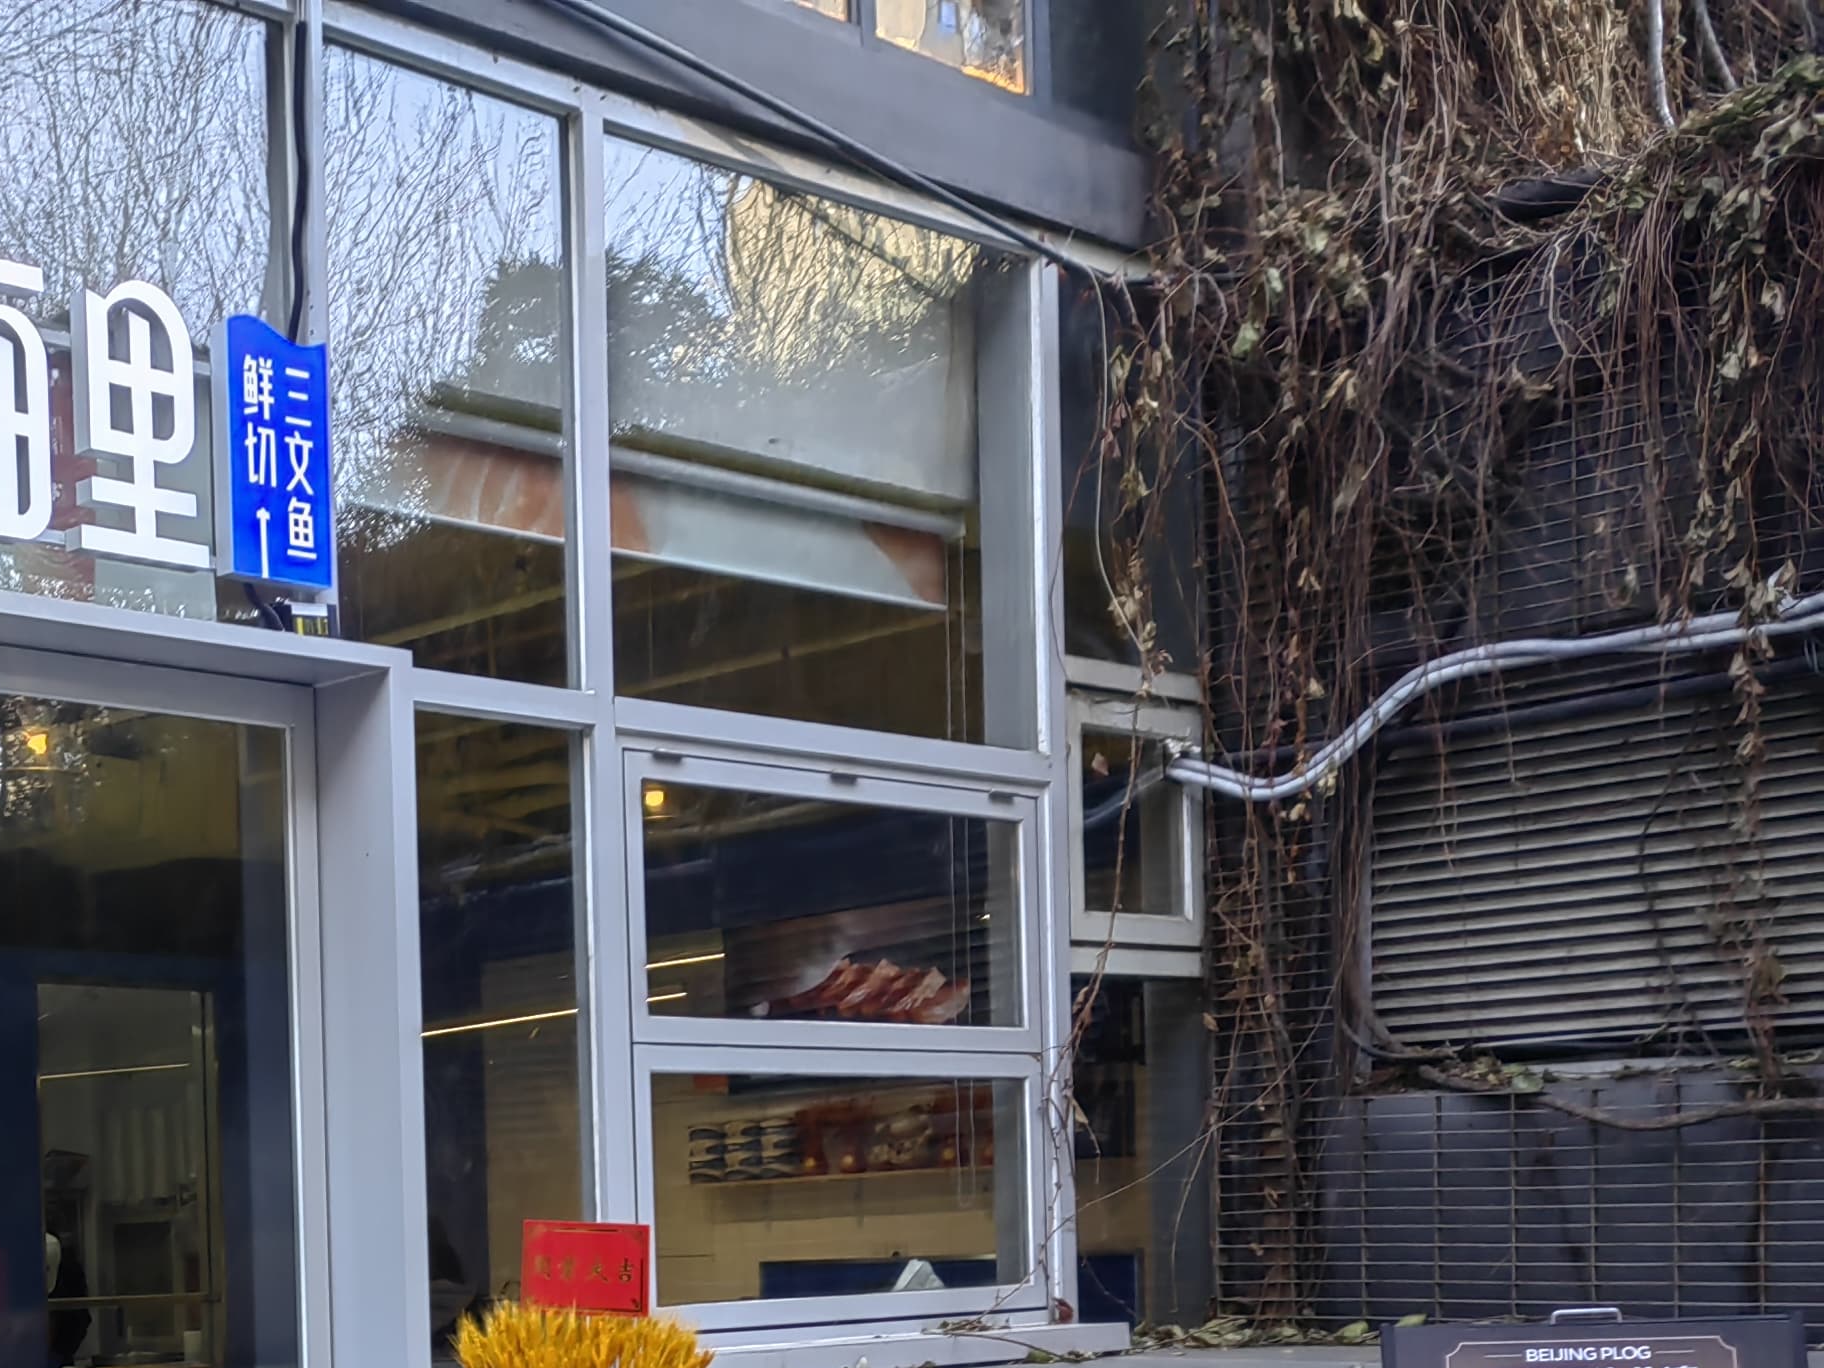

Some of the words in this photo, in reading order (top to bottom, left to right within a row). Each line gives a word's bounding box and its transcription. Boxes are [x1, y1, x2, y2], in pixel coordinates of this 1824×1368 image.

[242, 353, 278, 488] 鲜切
[284, 367, 317, 561] 三文鱼
[1525, 1347, 1597, 1362] BEIJING
[1600, 1346, 1651, 1361] PLOG
